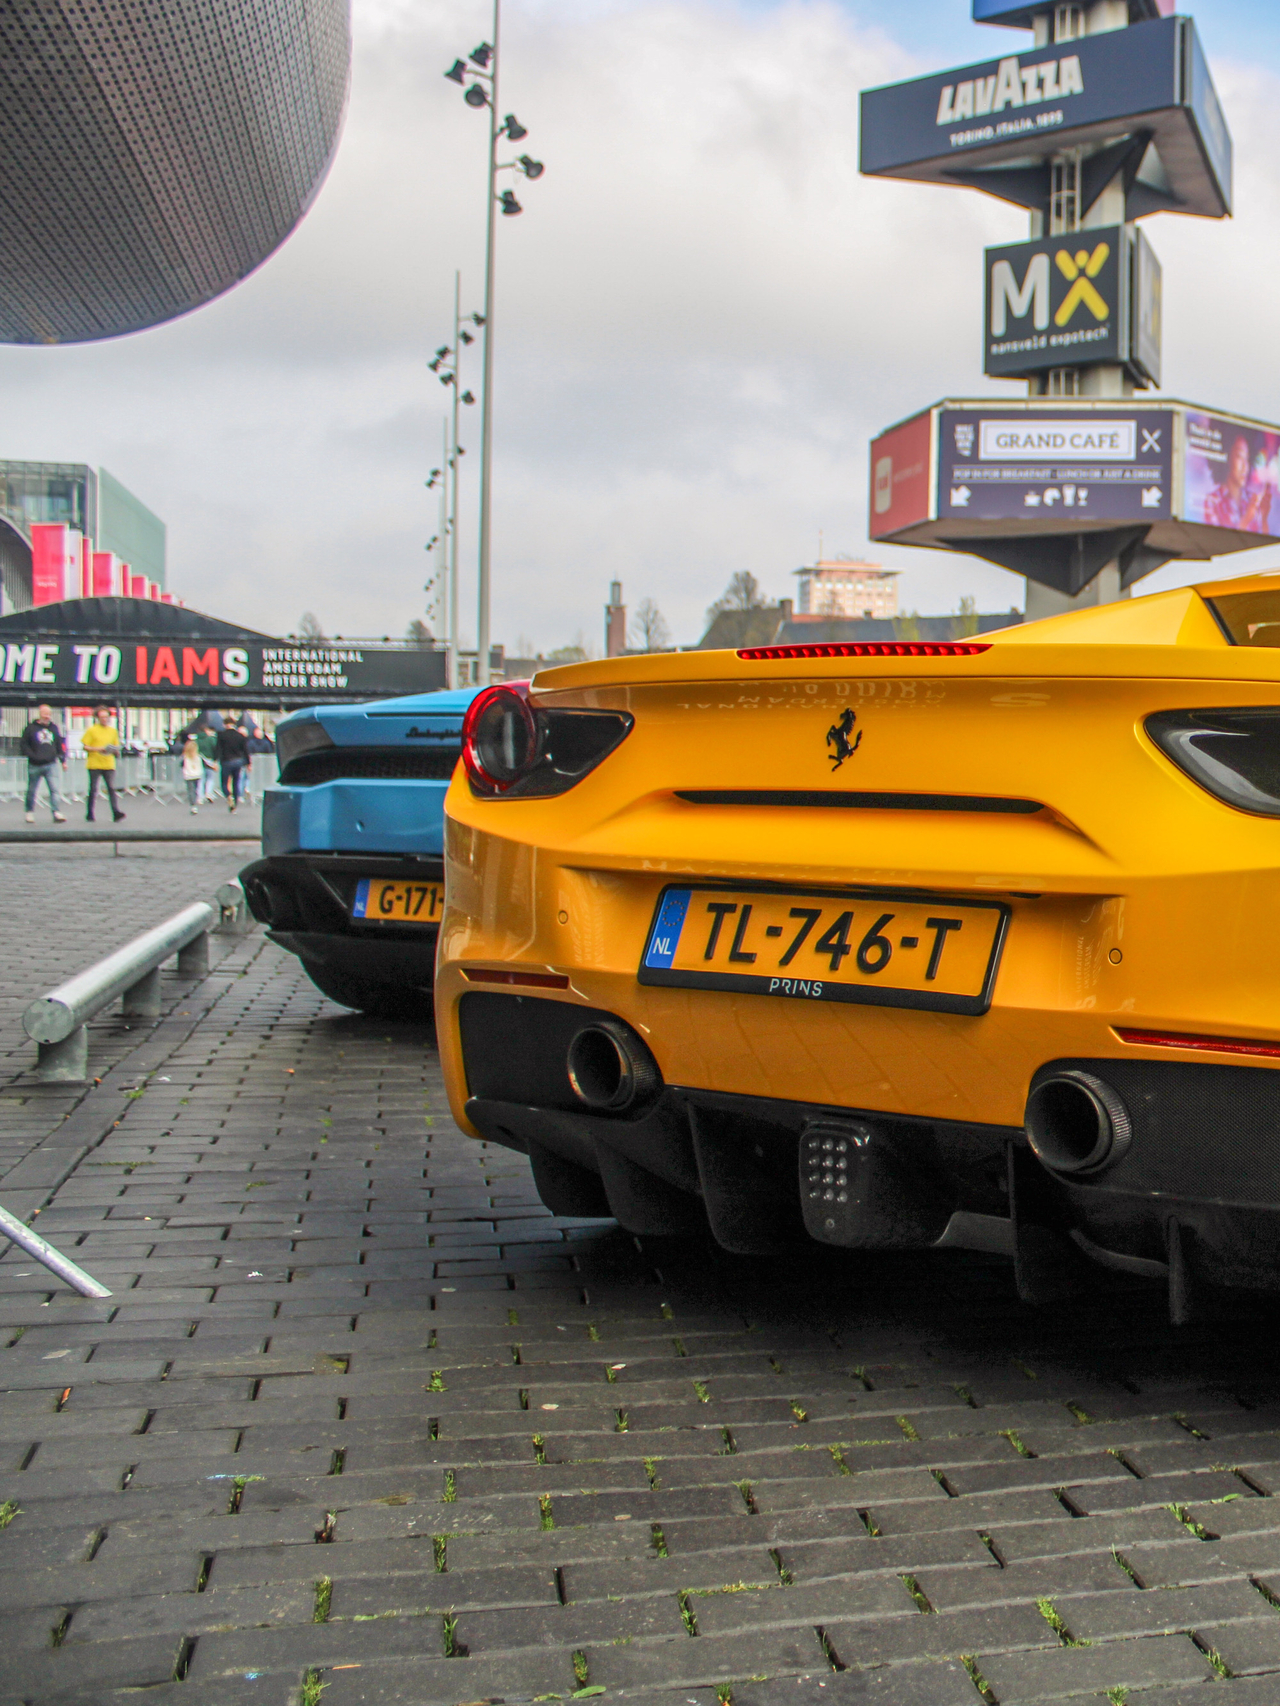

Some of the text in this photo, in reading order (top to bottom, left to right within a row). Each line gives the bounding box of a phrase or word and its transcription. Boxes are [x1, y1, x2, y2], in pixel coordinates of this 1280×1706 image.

[936, 55, 1084, 126] LAVAZZA
[995, 433, 1066, 449] GRAND
[1069, 430, 1120, 449] CAFÉ
[262, 648, 364, 662] INTERNATIONAL
[0, 644, 250, 687] ME TO IAMS
[262, 661, 343, 675] AMSTERDAM
[262, 674, 349, 688] MOTOR SHOW
[652, 937, 672, 956] NL
[704, 902, 963, 980] TL-746-T
[769, 978, 823, 997] PRINS
